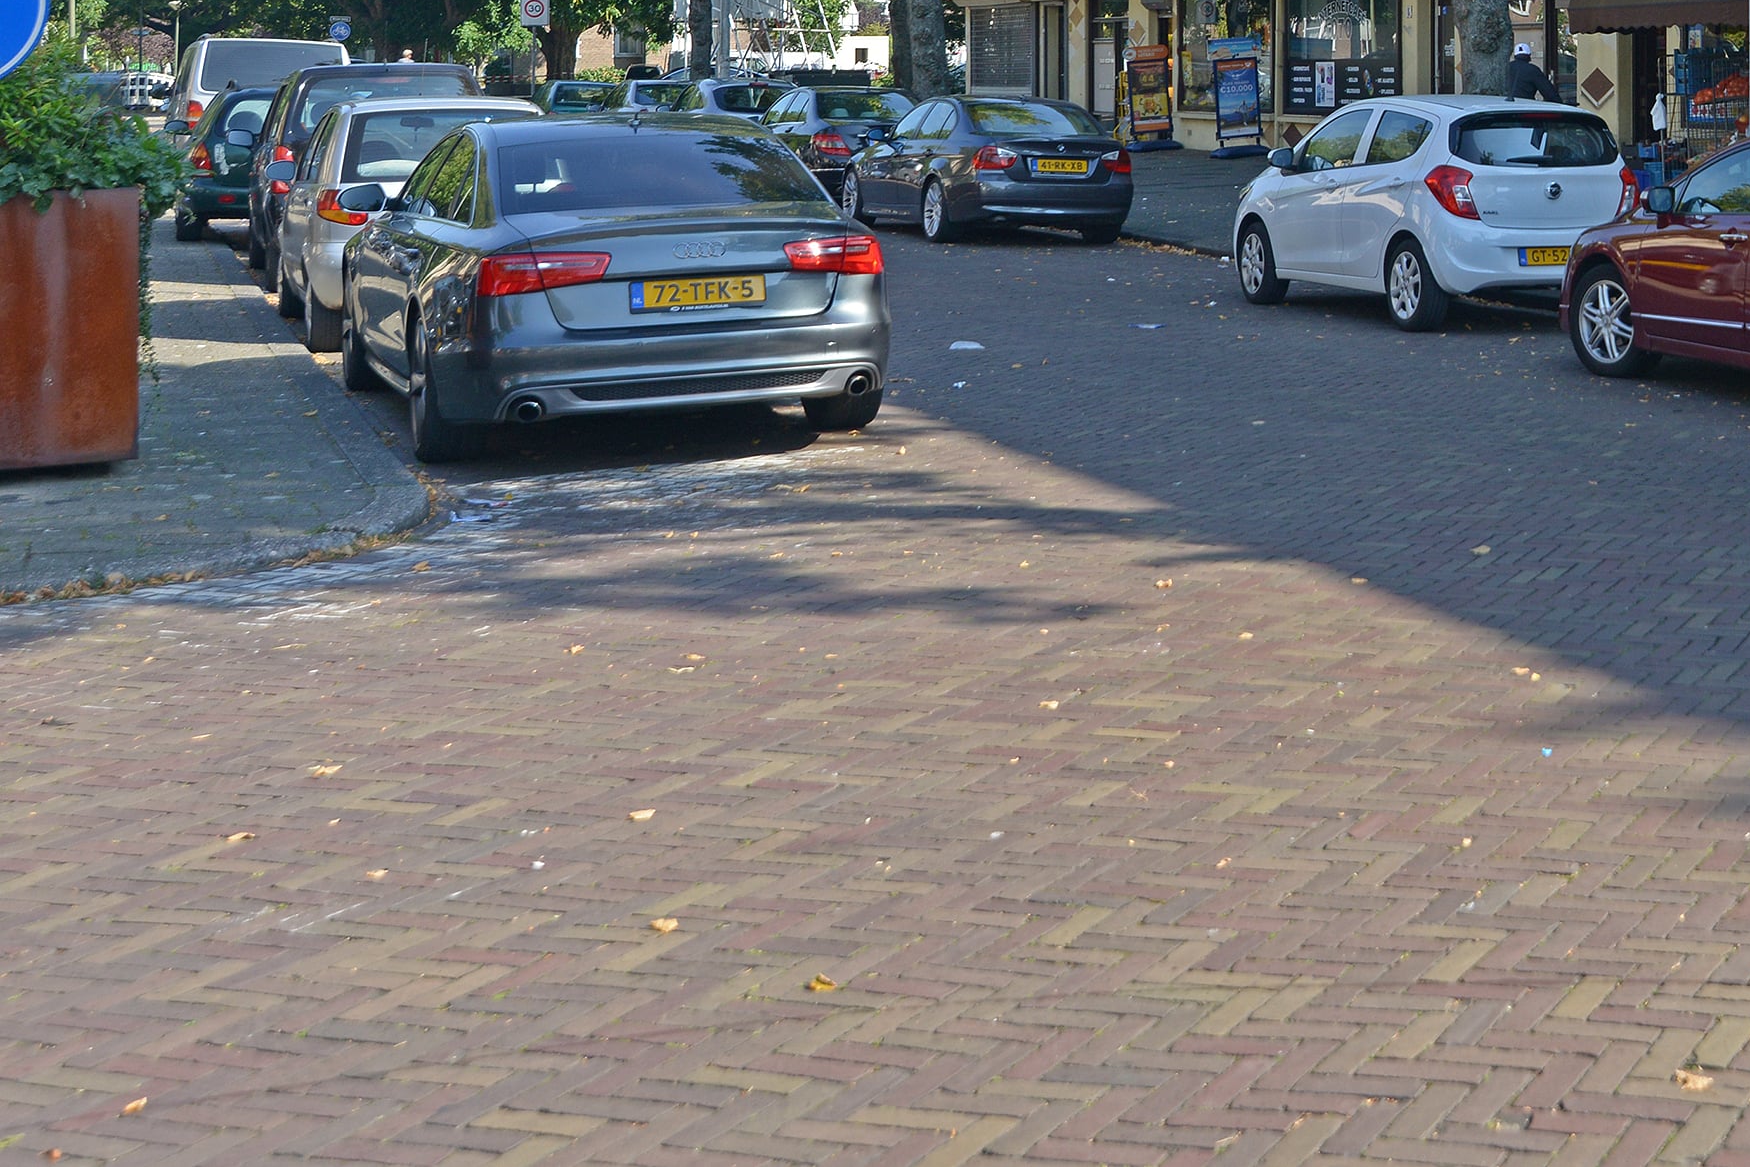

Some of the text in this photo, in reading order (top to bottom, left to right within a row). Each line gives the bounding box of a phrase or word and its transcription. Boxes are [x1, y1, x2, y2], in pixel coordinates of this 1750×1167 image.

[528, 4, 541, 13] 30
[1220, 84, 1253, 94] €10.000
[1041, 161, 1083, 171] 41-RK-XB
[653, 279, 754, 304] 72-TFK-5
